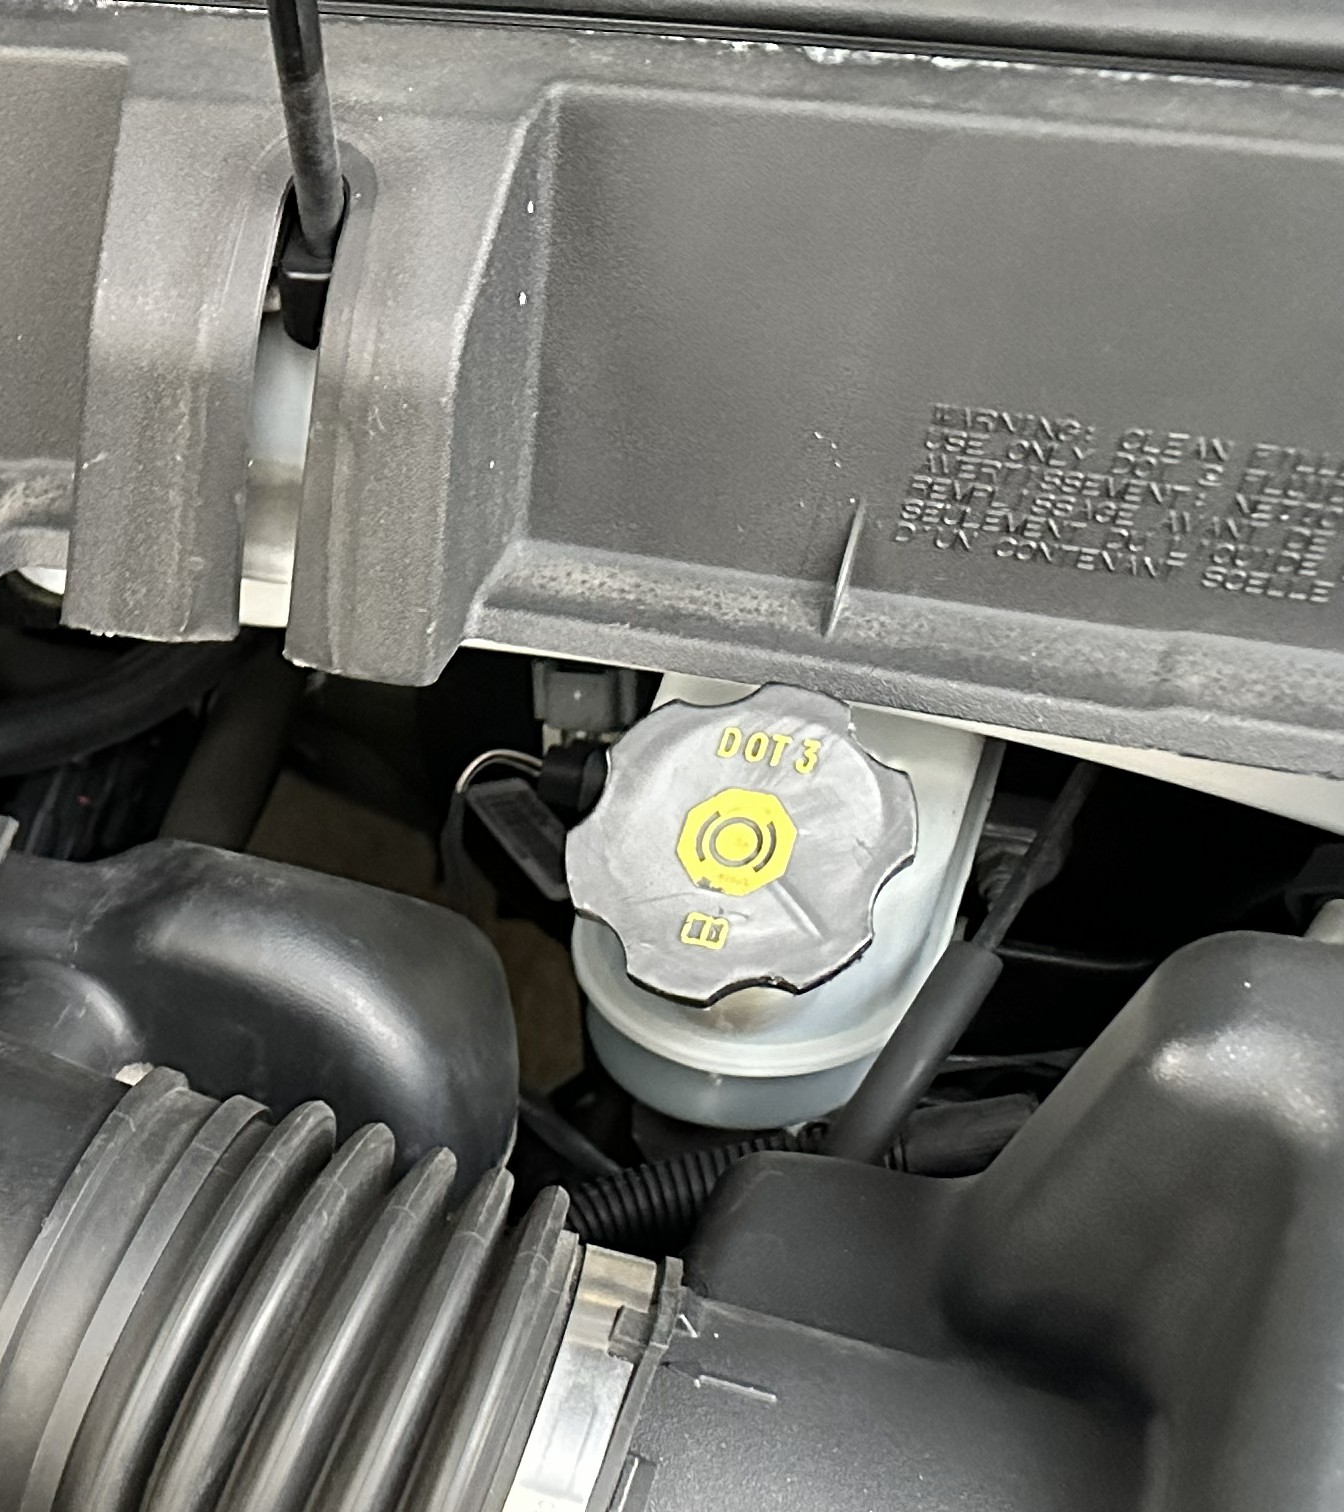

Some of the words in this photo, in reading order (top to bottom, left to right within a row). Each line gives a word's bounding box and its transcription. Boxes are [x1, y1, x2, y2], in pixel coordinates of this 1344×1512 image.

[925, 425, 991, 456] USE
[1006, 438, 1099, 468] ONLY
[1110, 450, 1183, 482] DOT
[1197, 463, 1224, 487] 3
[1122, 427, 1236, 462] CLEAN
[716, 726, 793, 768] DOT
[795, 738, 823, 775] 3
